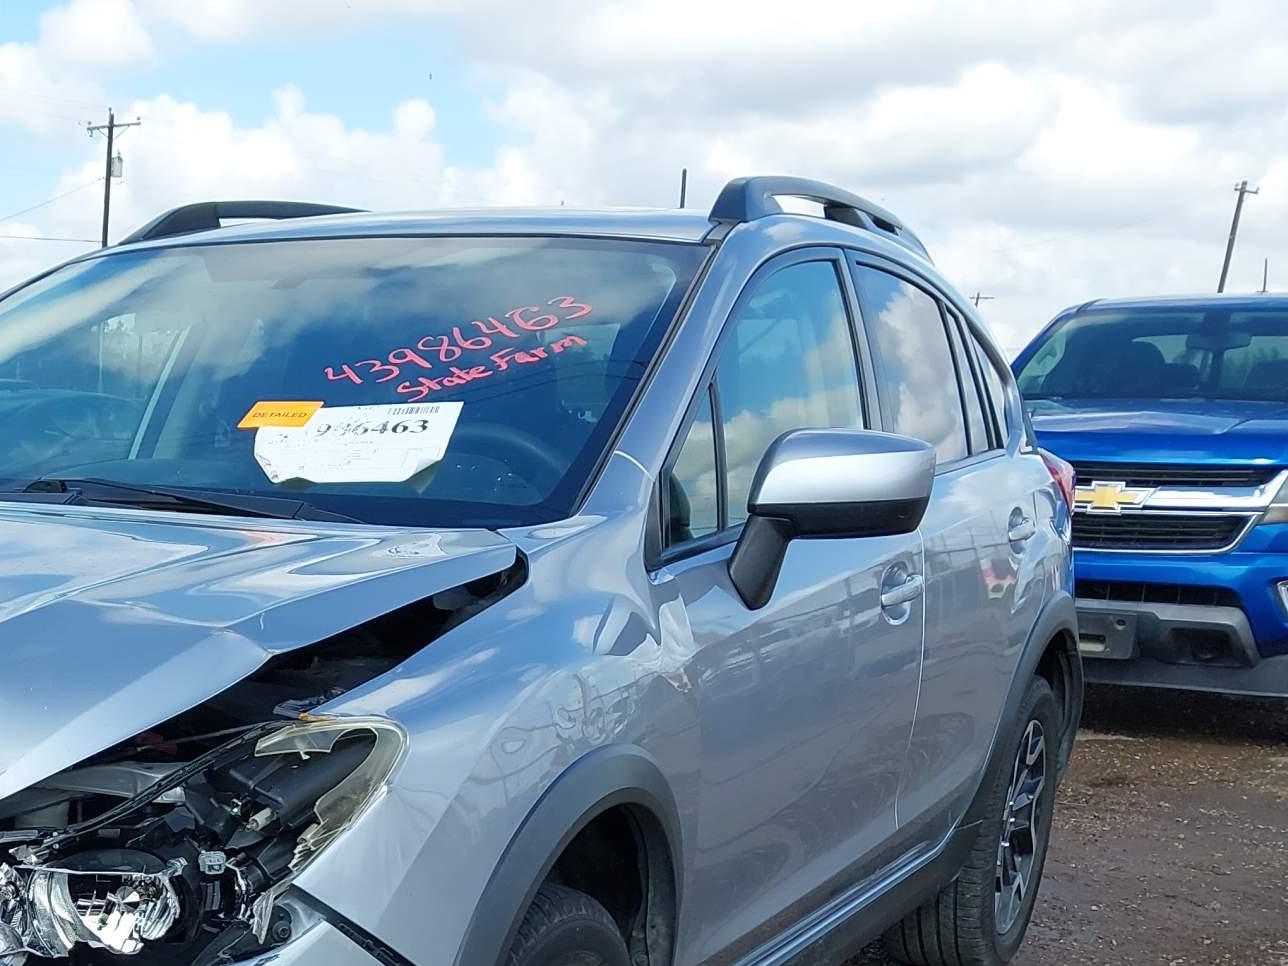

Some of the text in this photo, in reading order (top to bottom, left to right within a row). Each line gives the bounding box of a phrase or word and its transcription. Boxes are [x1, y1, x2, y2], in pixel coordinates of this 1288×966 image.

[324, 296, 593, 385] 43986463
[397, 335, 587, 402] State Farm
